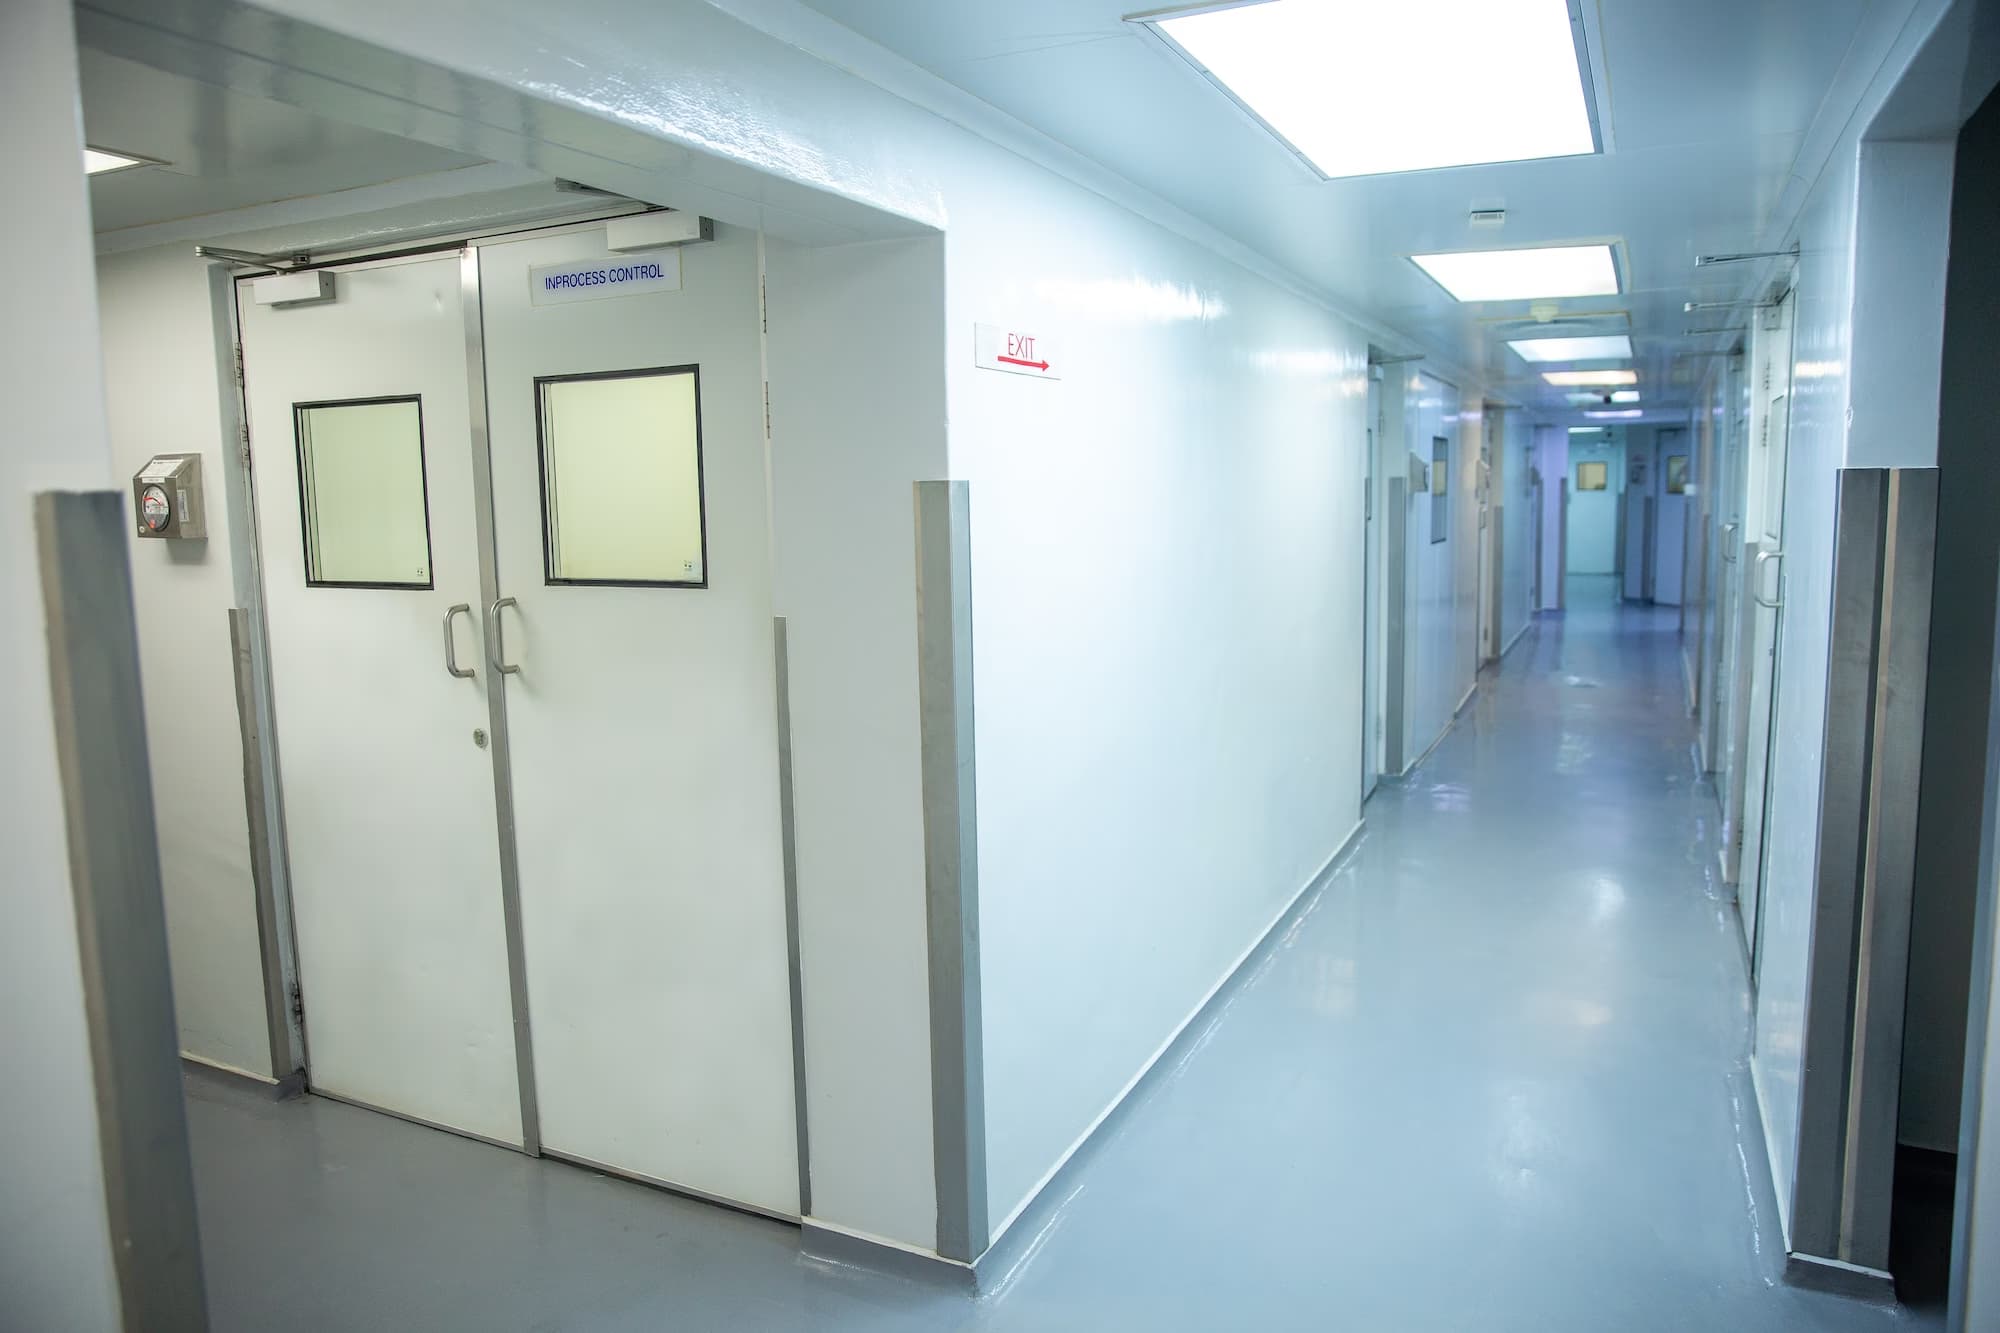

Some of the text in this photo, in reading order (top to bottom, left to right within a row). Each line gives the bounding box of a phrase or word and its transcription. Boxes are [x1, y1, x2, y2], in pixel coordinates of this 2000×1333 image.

[545, 264, 664, 290] INPROCESS CONTROL
[1008, 333, 1036, 359] EXIT
